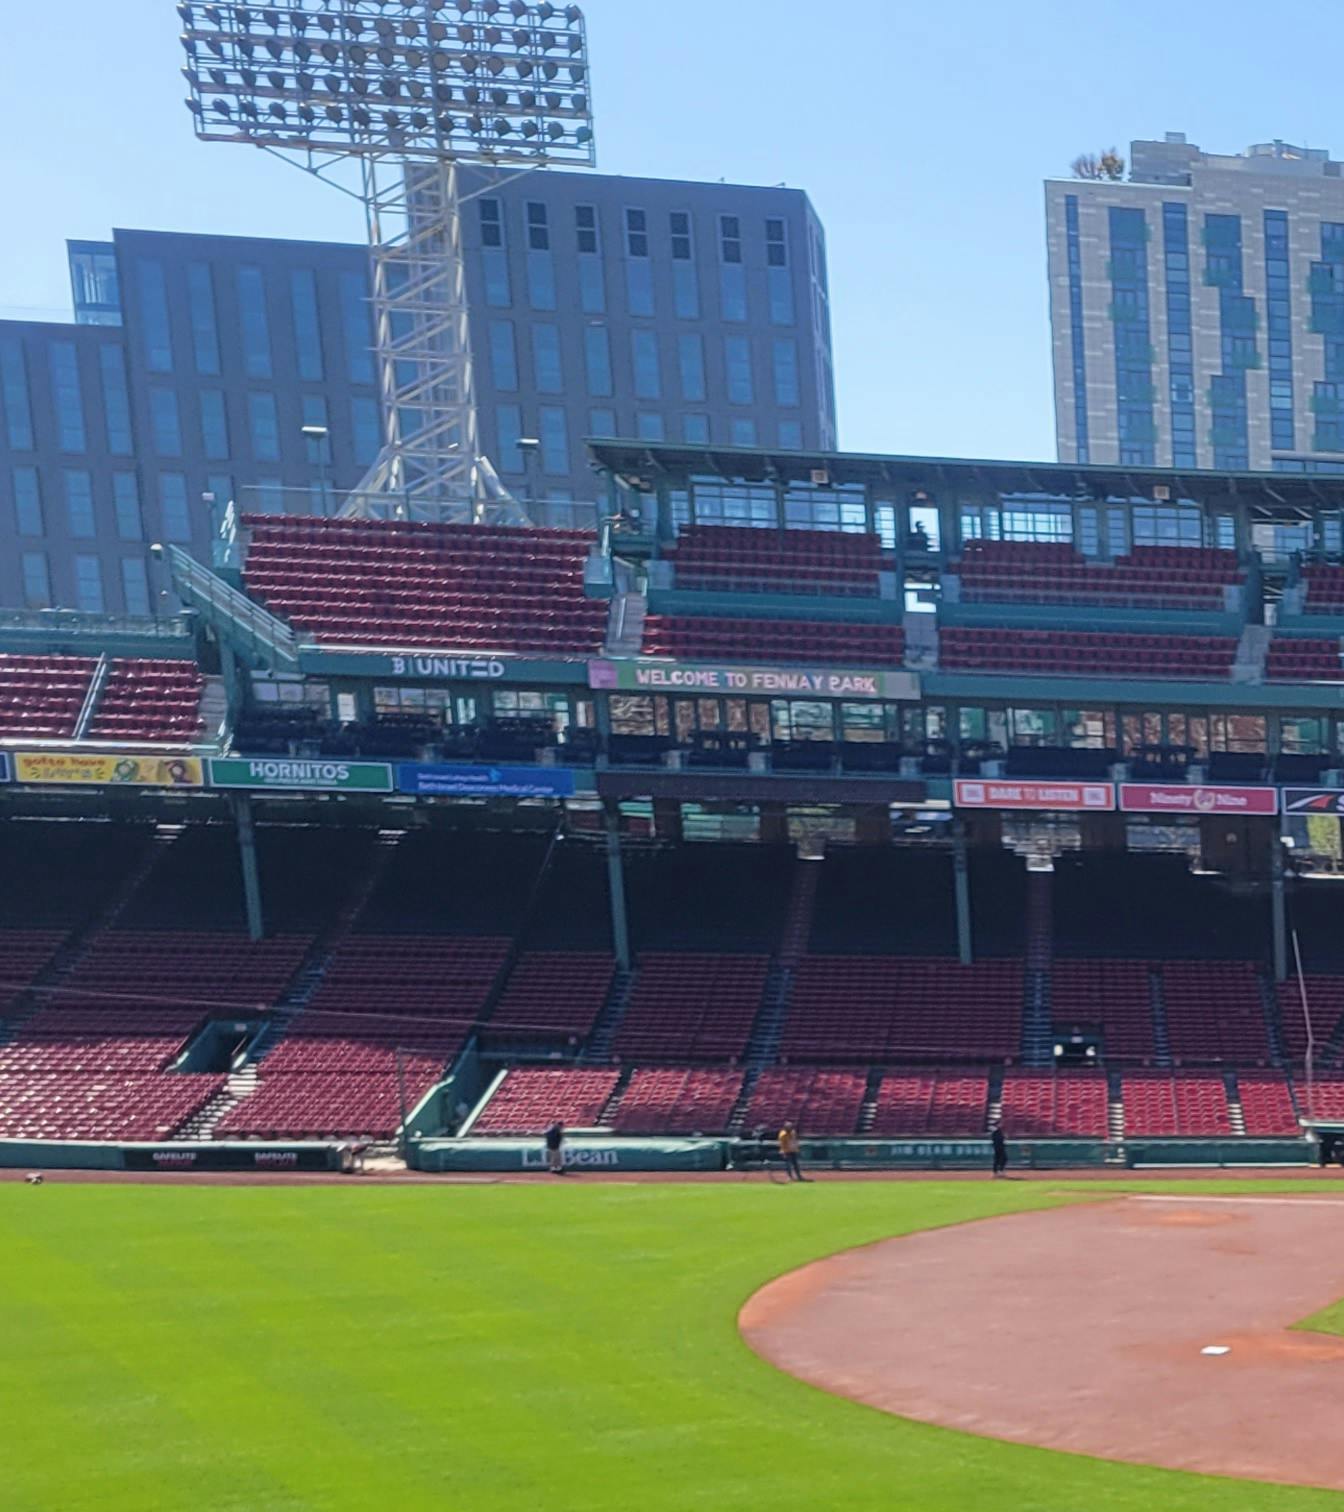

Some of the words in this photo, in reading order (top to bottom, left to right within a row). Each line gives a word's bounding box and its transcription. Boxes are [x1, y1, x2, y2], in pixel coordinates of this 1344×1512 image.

[417, 659, 504, 677] UNITED
[636, 668, 718, 686] WELCOME
[725, 672, 747, 687] TO
[752, 673, 823, 691] FENWAY
[829, 675, 877, 693] PARK
[251, 762, 349, 779] HORNITOS
